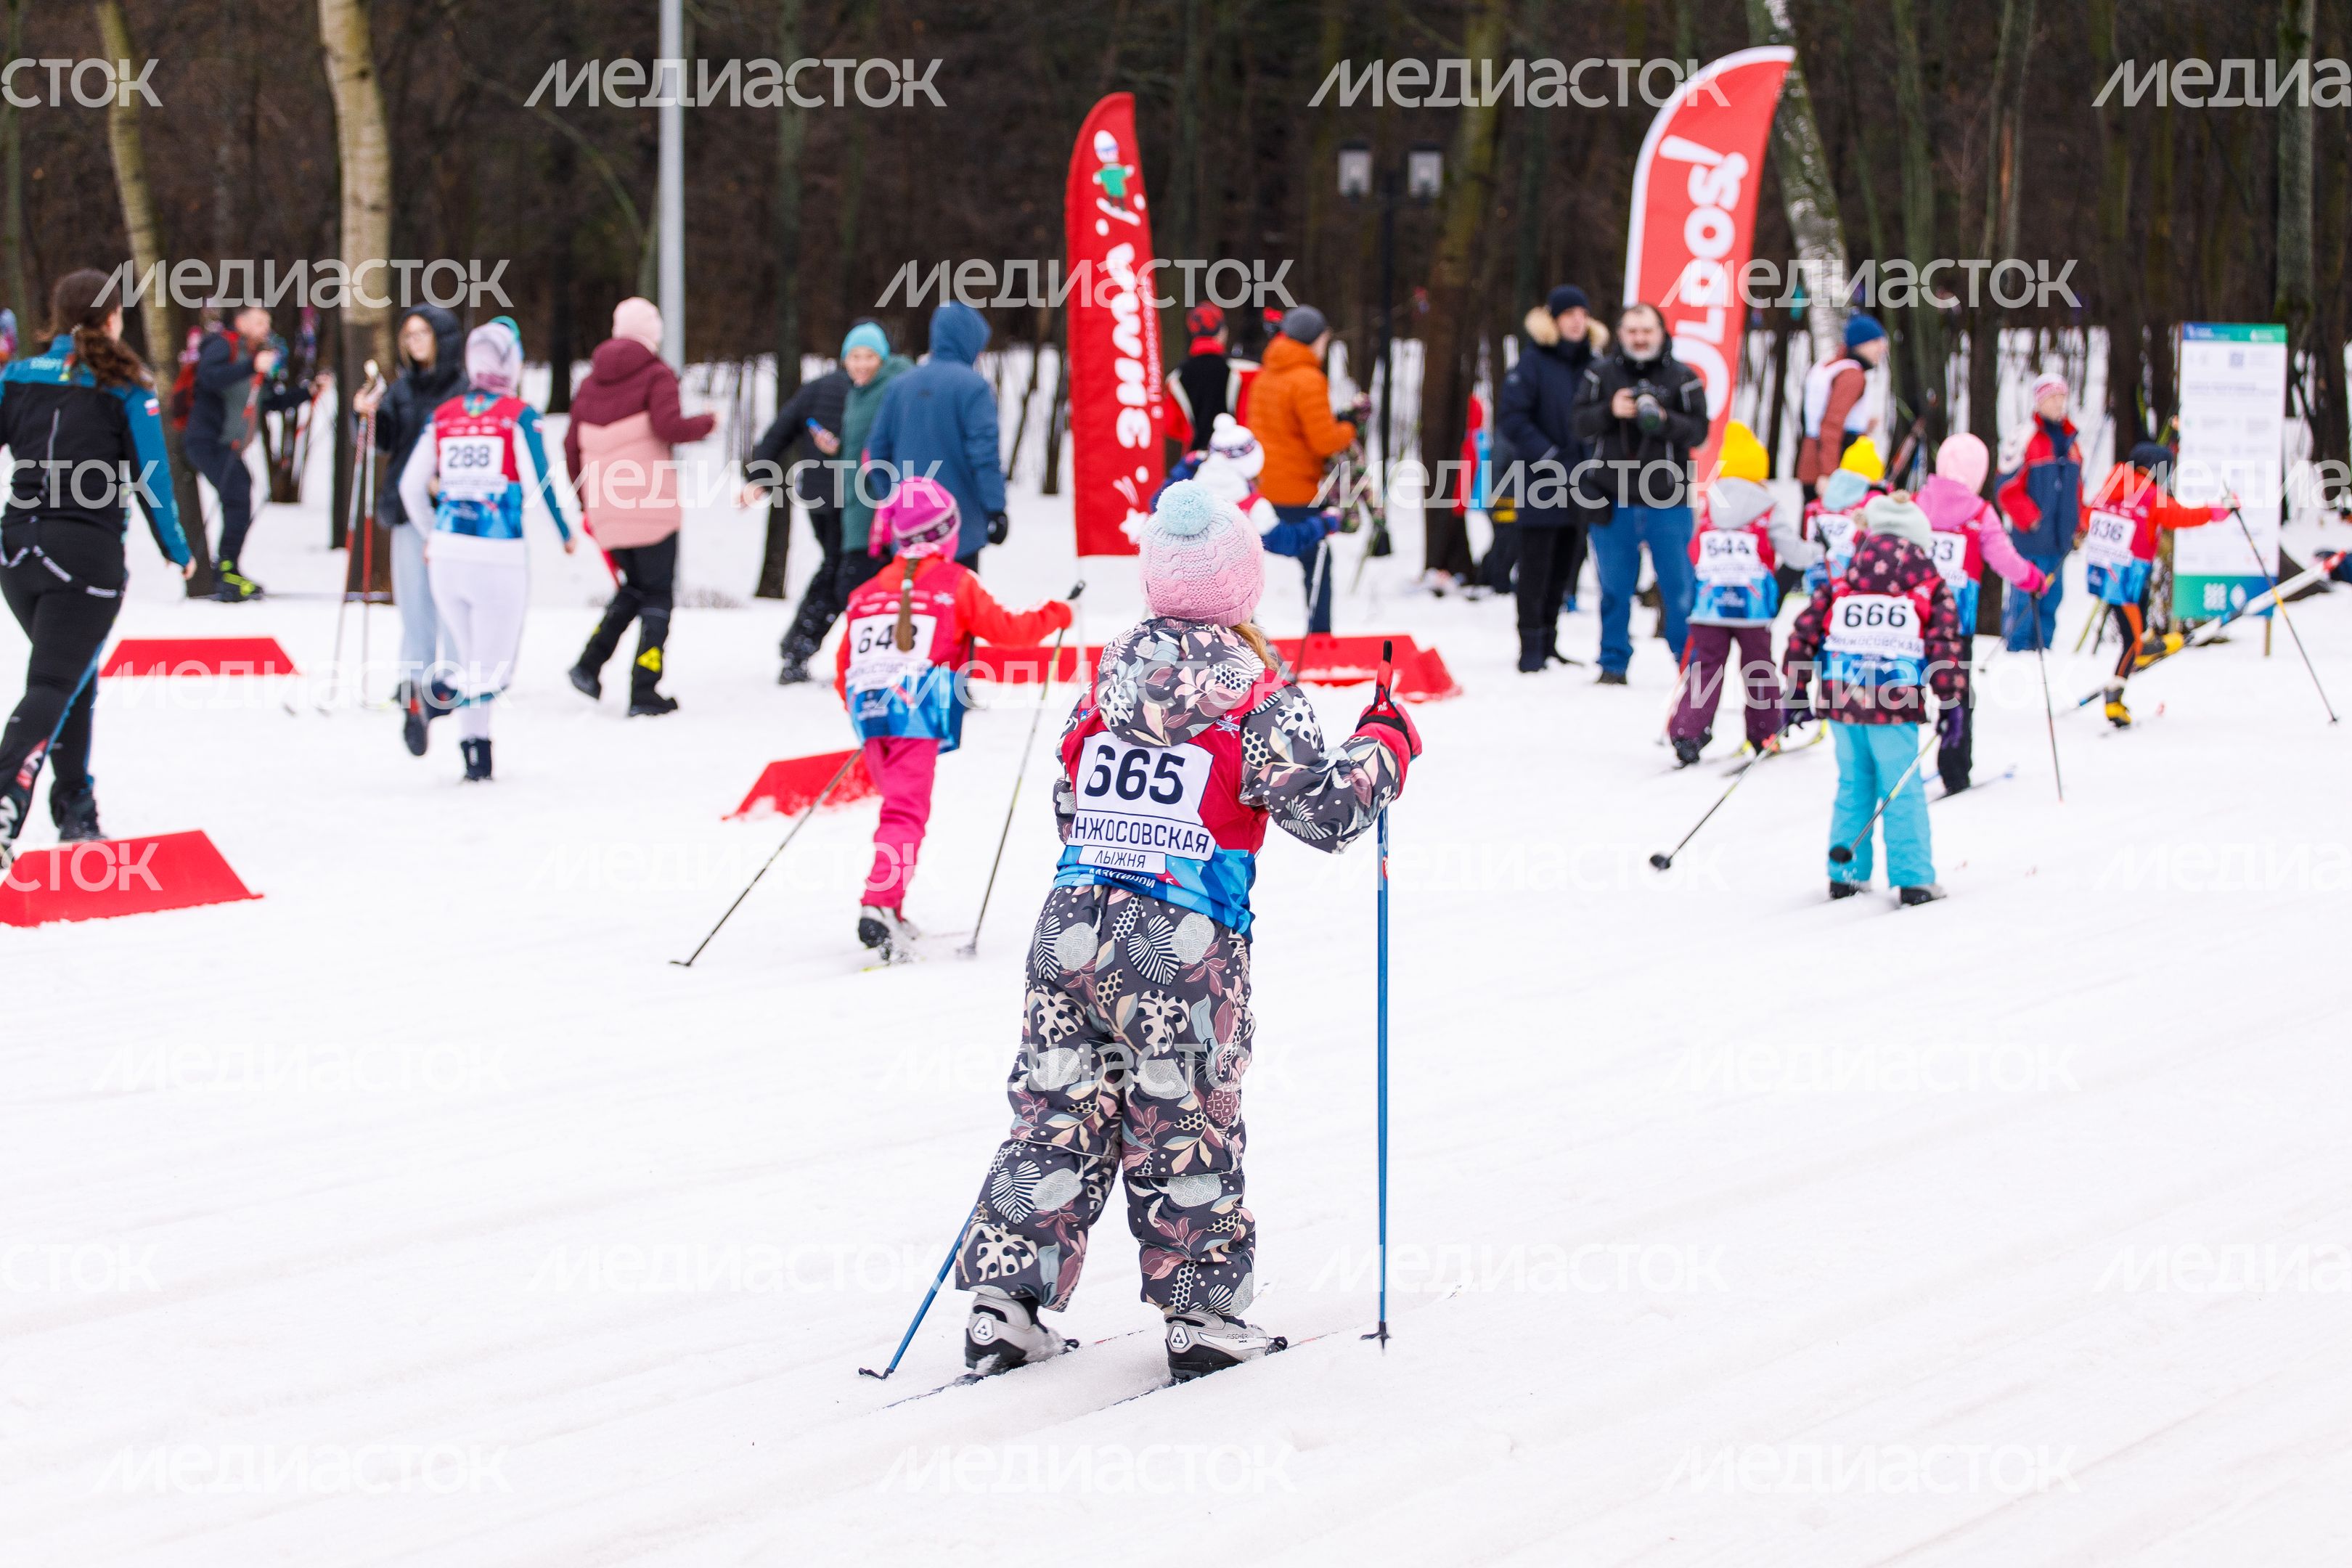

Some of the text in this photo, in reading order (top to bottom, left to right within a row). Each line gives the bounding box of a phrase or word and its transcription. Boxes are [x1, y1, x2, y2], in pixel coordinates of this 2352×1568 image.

[448, 444, 491, 469] 288
[1707, 537, 1750, 556] 644
[1844, 603, 1907, 627] 666
[1085, 745, 1185, 804] 665
[1069, 816, 1210, 854] НЖОСОВСКАЯ
[1095, 850, 1146, 869] ЛЫЖНЯ
